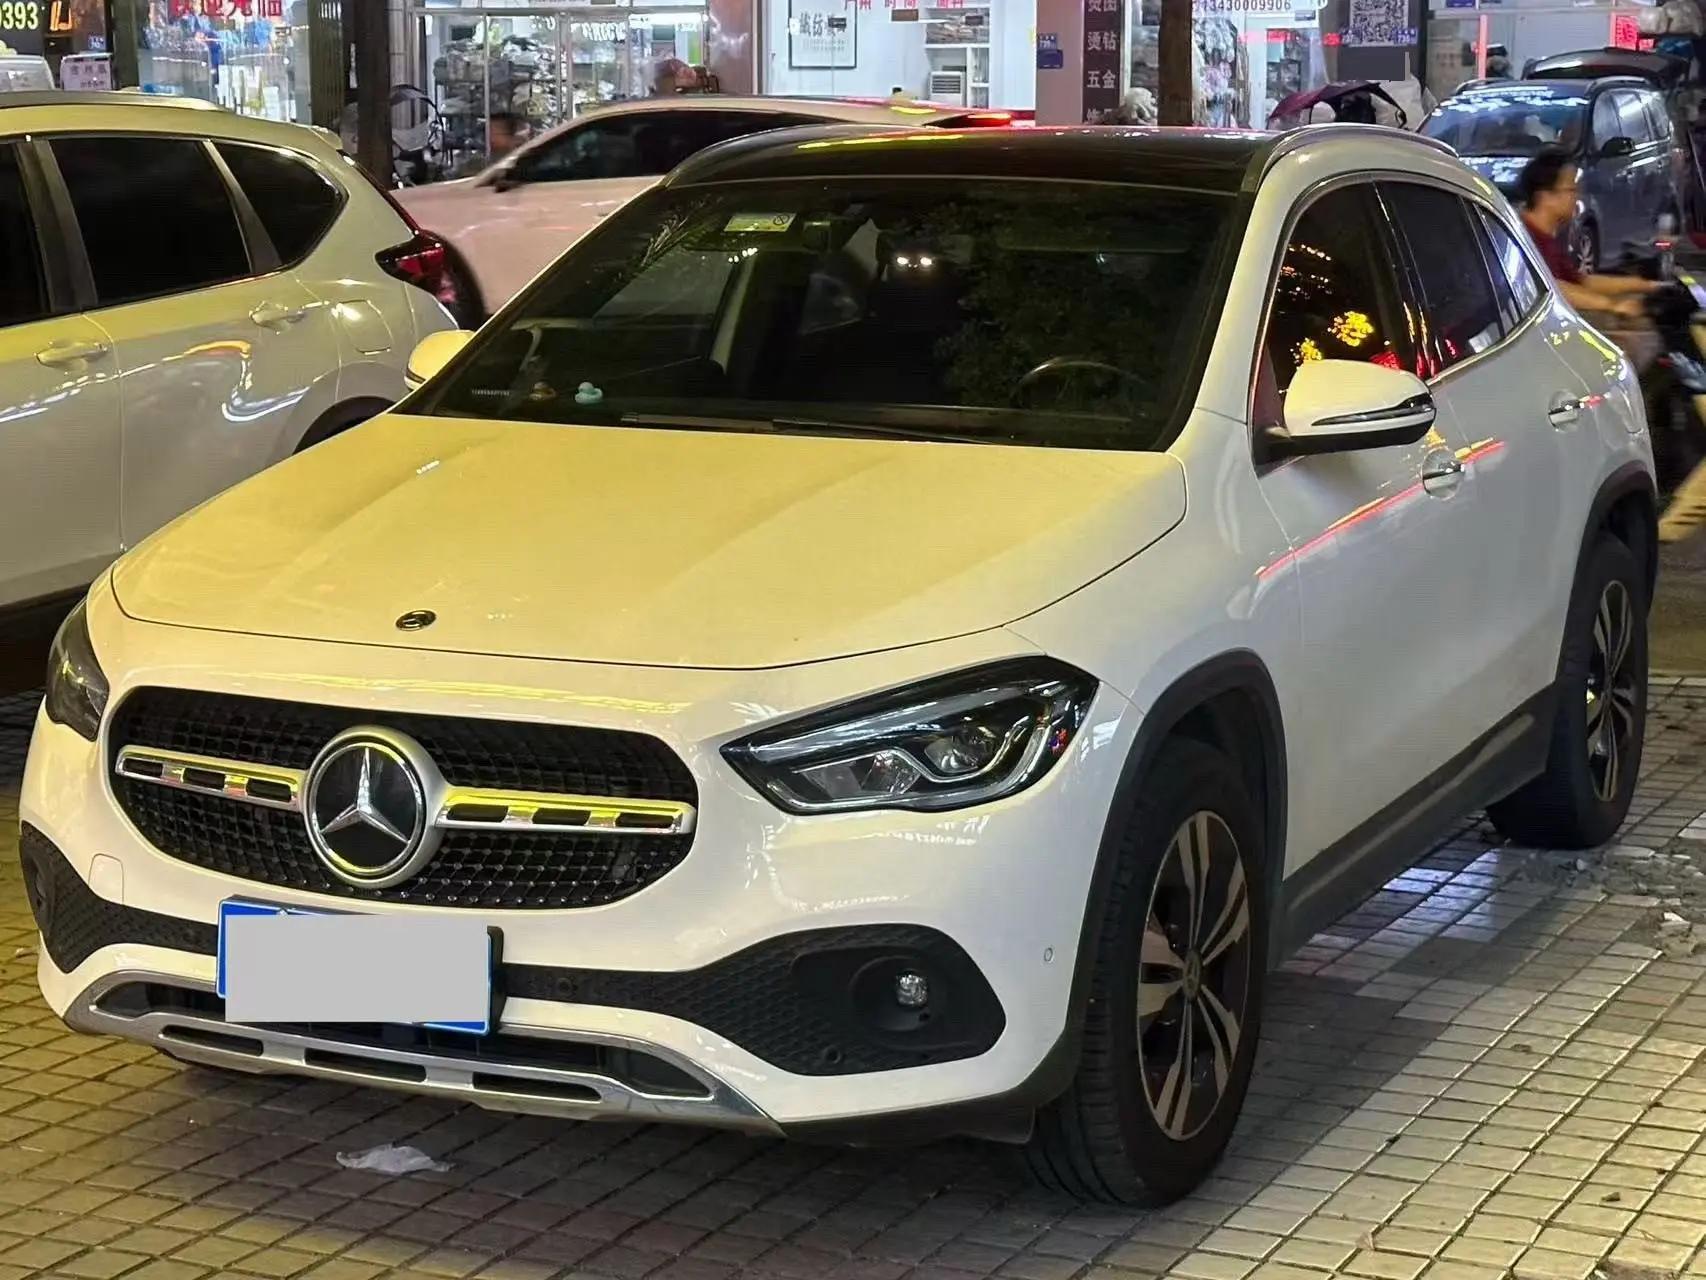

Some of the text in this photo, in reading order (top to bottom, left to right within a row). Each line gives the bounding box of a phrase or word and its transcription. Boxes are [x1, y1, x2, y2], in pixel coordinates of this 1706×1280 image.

[0, 1, 38, 30] 393
[1087, 31, 1118, 51] 烫钻
[1086, 70, 1117, 89] 五金
